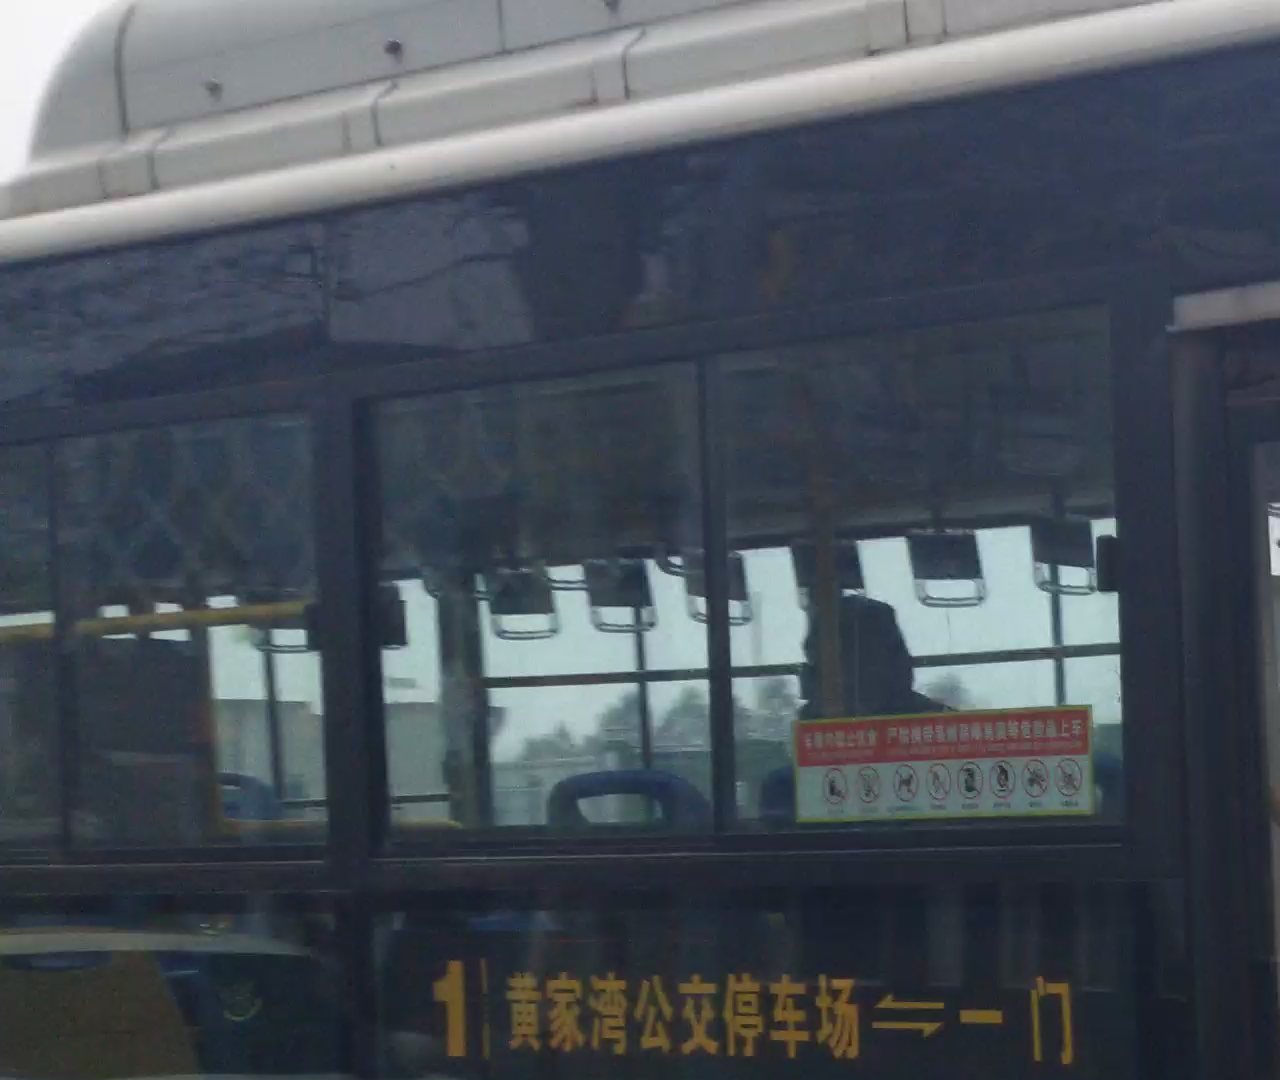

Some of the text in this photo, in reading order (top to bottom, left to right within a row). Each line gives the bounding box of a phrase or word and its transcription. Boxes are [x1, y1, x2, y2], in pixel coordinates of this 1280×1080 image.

[433, 959, 1076, 1066] 1 黄家湾公交停车场 一门
